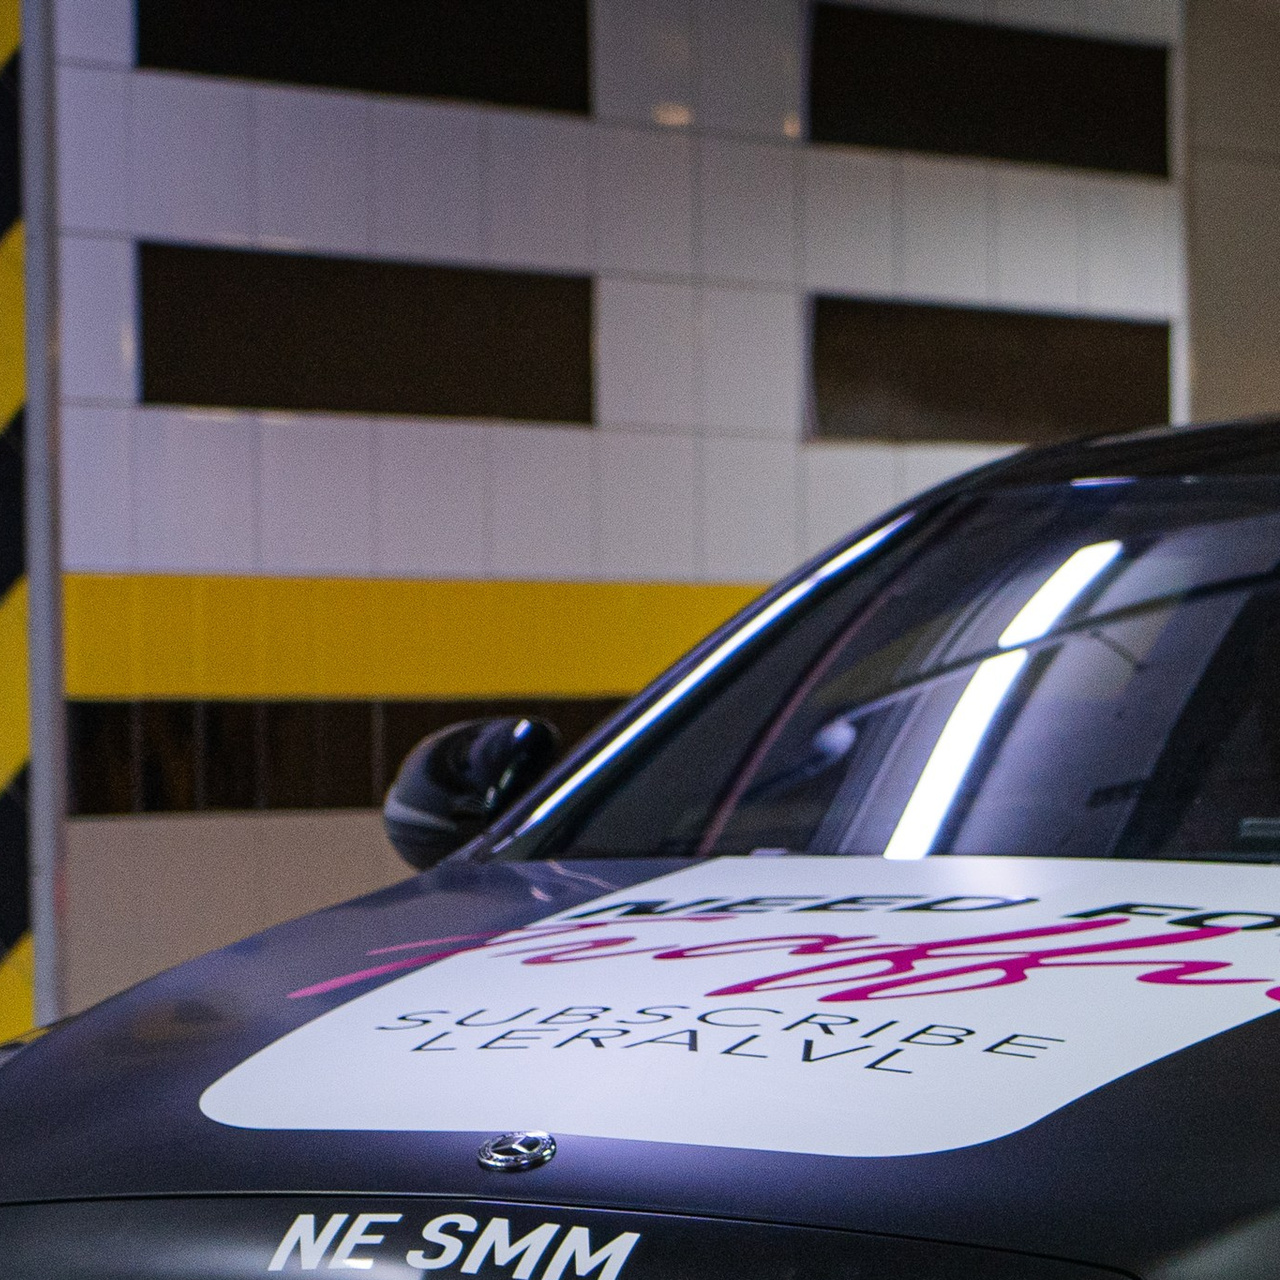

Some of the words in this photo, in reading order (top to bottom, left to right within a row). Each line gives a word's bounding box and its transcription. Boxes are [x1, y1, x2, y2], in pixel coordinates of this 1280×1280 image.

[564, 894, 1040, 921] NEED
[375, 1004, 1066, 1060] SUBSCRIBE
[411, 1028, 915, 1075] LERALVL
[267, 1213, 403, 1272] NE
